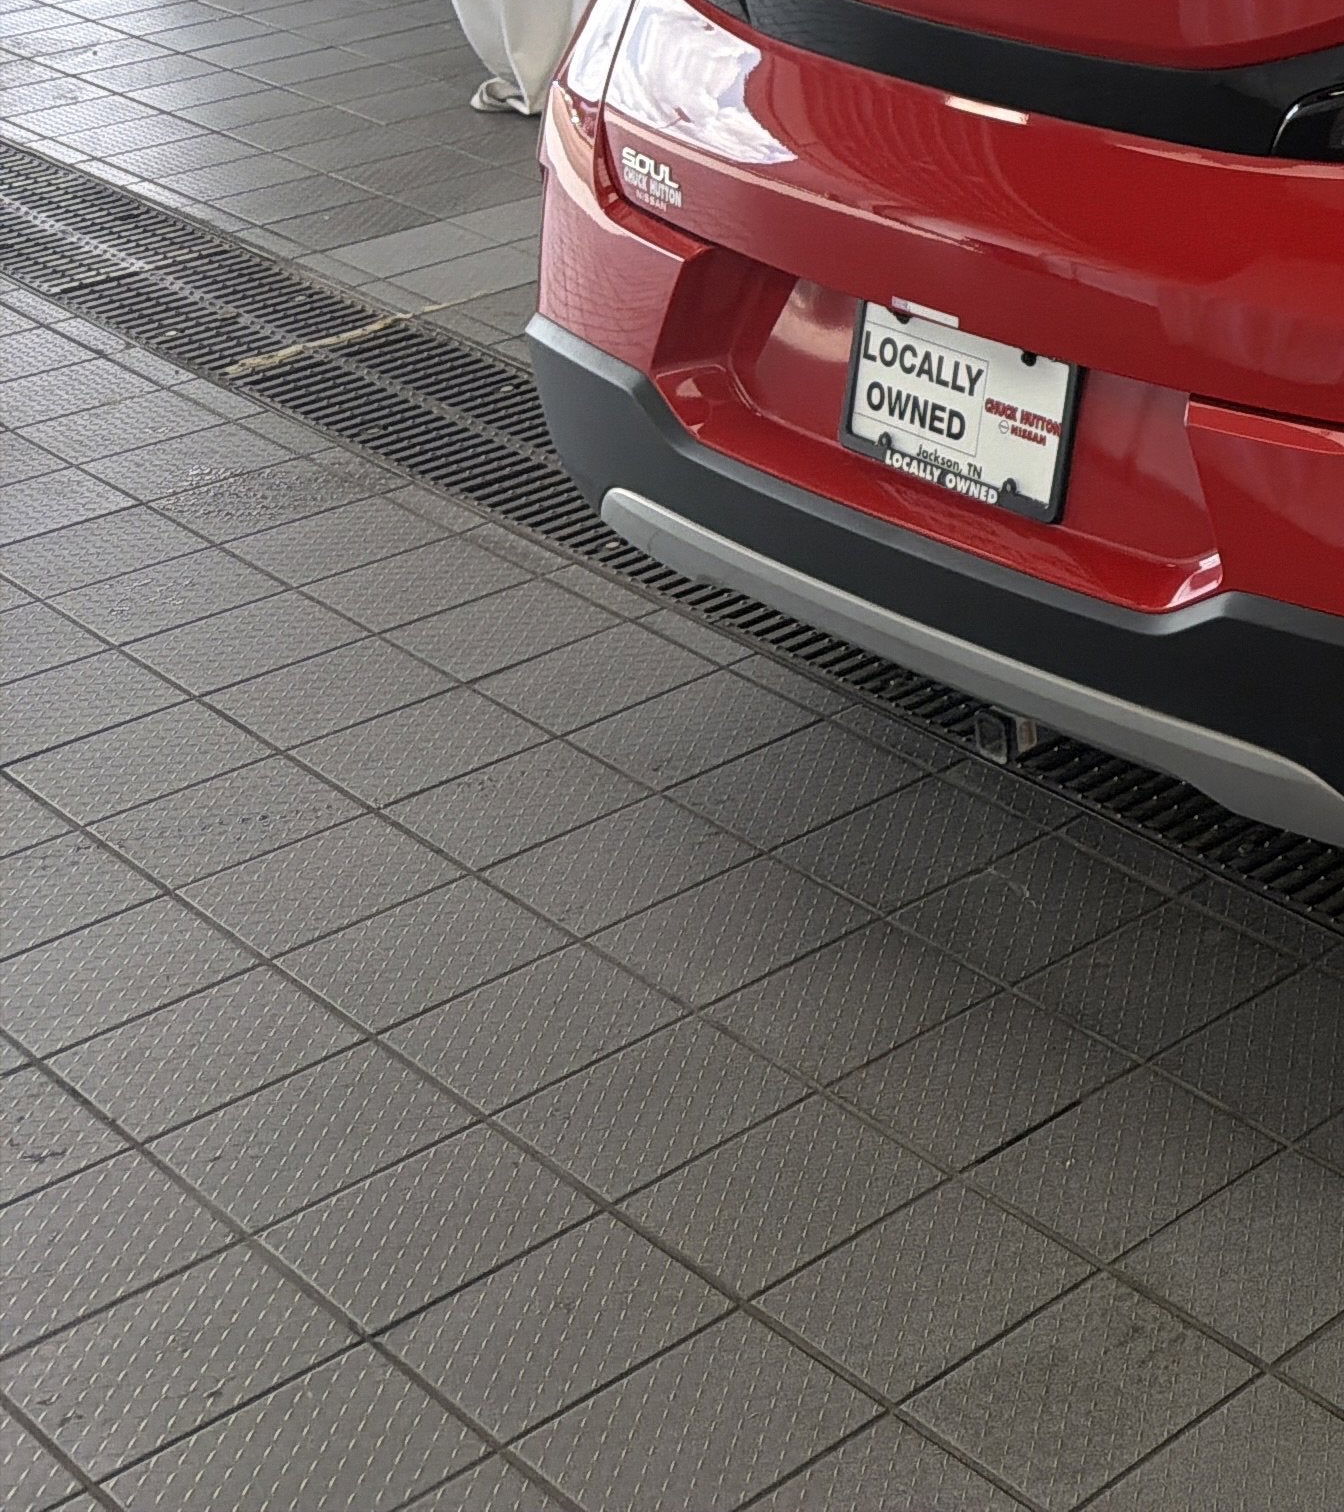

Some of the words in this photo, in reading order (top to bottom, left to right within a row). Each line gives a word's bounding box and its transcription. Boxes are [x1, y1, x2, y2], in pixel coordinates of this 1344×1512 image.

[621, 146, 679, 189] SOUL
[649, 178, 682, 208] HUTTON
[862, 330, 984, 397] LOCALLY
[866, 381, 966, 441] OWNED
[984, 397, 1018, 422] CHUCK
[1019, 408, 1063, 436] HUTTON
[1010, 423, 1047, 446] NISSAN
[884, 449, 942, 483] LOCALLY
[945, 473, 998, 504] OWNED
[916, 444, 963, 476] Jackson,
[966, 462, 983, 480] TN
